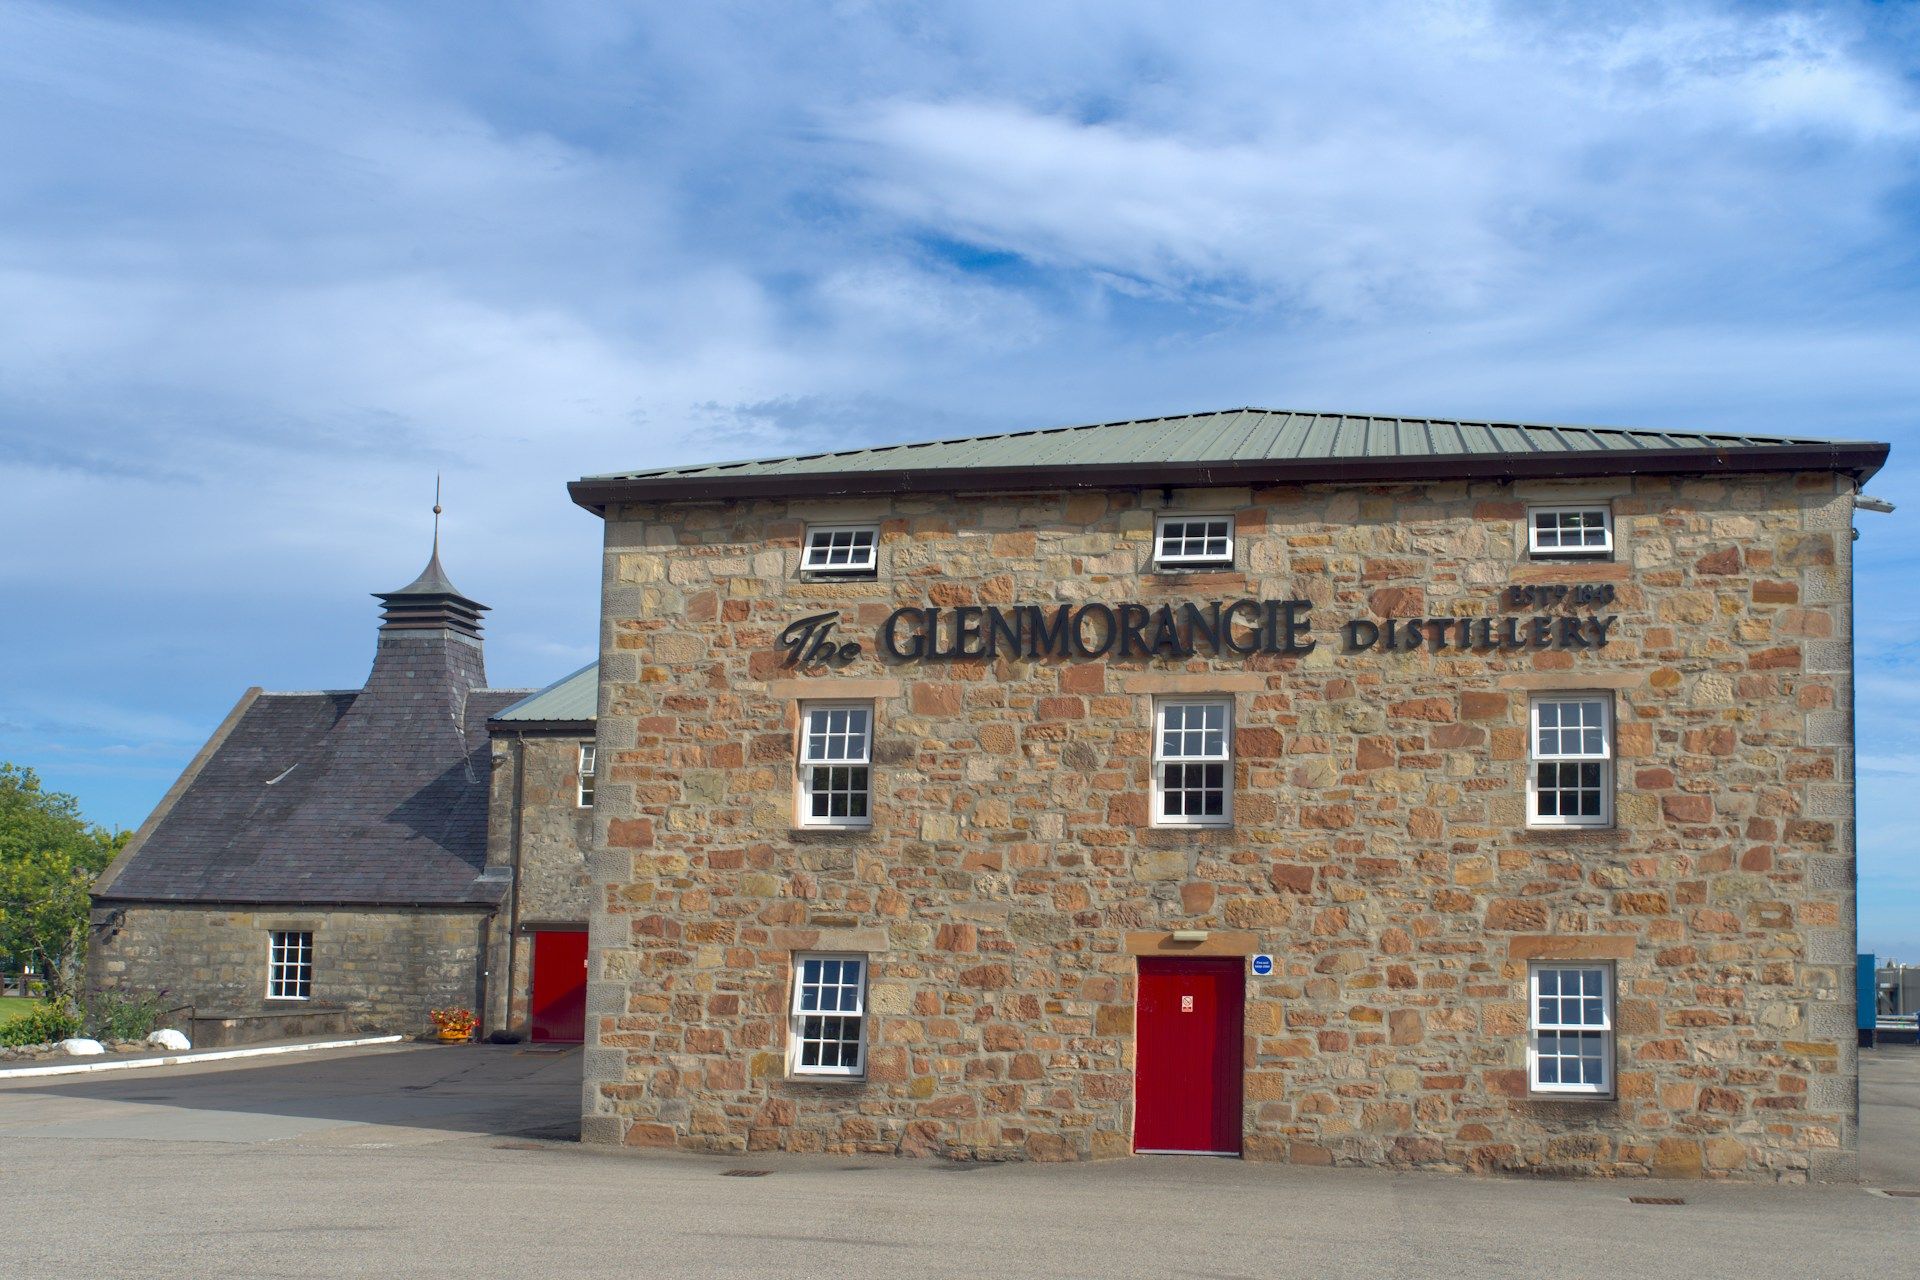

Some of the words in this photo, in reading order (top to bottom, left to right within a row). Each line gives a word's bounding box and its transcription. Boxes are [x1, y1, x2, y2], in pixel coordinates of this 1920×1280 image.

[1576, 584, 1615, 604] 1843
[781, 610, 861, 664] The
[885, 600, 1316, 661] GLENMORANGIE
[1350, 615, 1618, 649] DISTILLERY
